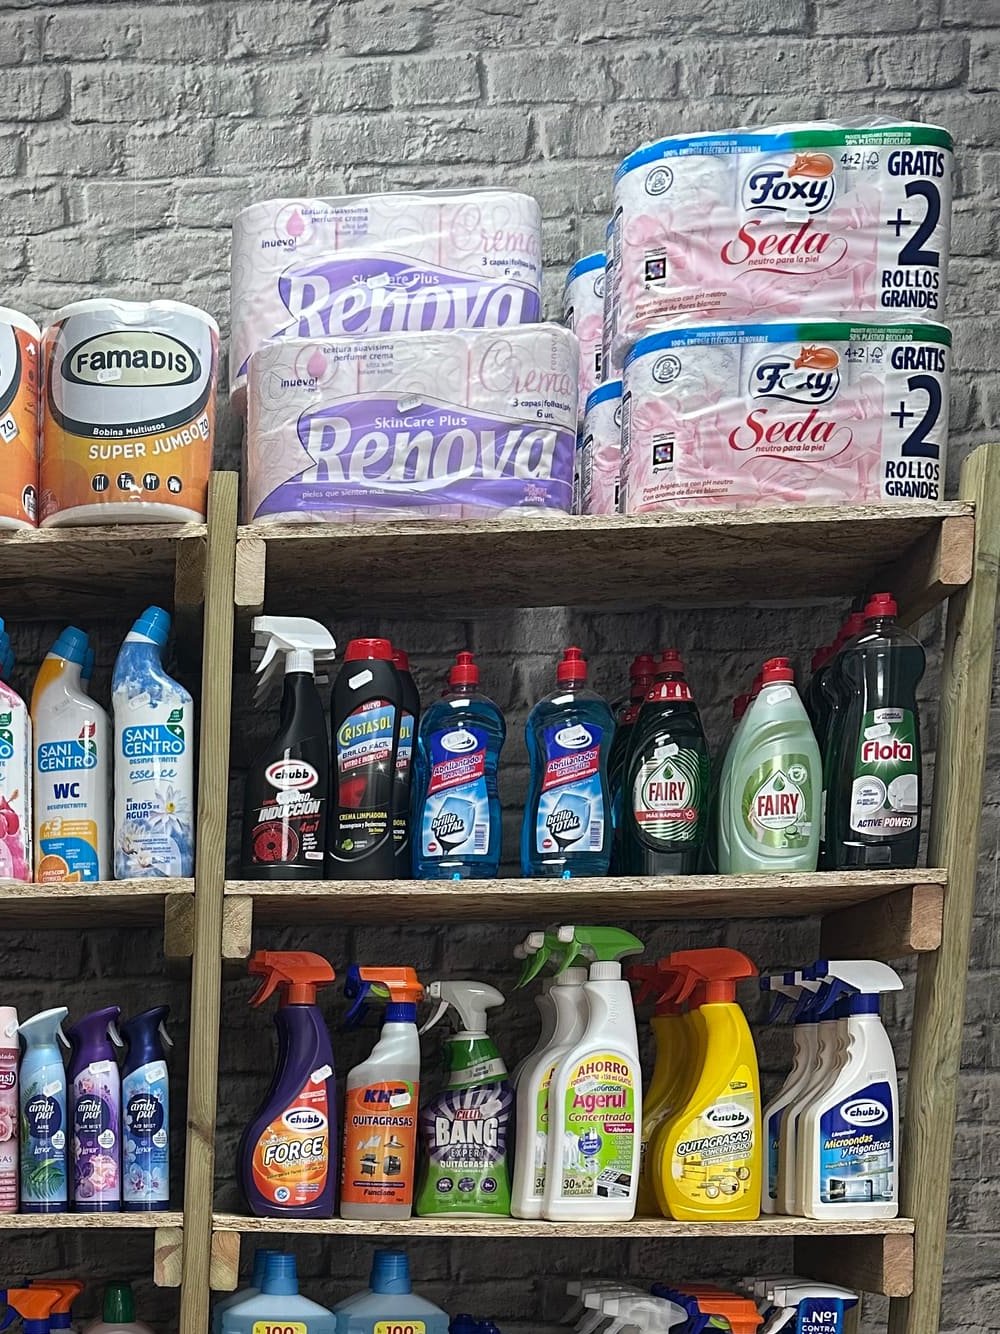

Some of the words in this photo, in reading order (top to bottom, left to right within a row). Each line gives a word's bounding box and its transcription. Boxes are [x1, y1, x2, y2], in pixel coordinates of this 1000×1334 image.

[888, 151, 944, 178] GRATIS
[750, 170, 826, 207] Foxy
[720, 218, 832, 265] Seda
[748, 256, 775, 265] neutro
[776, 257, 795, 265] para
[881, 270, 939, 289] ROLLOS
[284, 274, 526, 337] Renova
[881, 290, 938, 309] GRANDES
[891, 347, 945, 371] GRATIS
[93, 425, 121, 437] Bobina
[123, 422, 166, 435] Multiusos
[375, 417, 434, 429] SkinCare
[439, 415, 467, 426] Plus
[729, 408, 836, 451] Seda
[89, 444, 146, 460] SUPER
[152, 427, 200, 455] JUMBO
[301, 417, 557, 483] Renova
[885, 462, 939, 480] ROLLOS
[885, 480, 939, 500] GRANDES
[125, 728, 158, 742] SANI
[41, 745, 71, 759] SANI
[125, 740, 183, 755] CENTRO
[40, 756, 95, 770] CENTRO
[274, 768, 310, 781] chubb
[53, 783, 80, 799] WC
[649, 781, 685, 802] FAIRY
[126, 802, 153, 811] LIRIOS
[757, 793, 800, 817] FAIRY
[126, 810, 149, 819] AGUA
[857, 818, 883, 828] ACTIVE
[883, 817, 913, 828] POWER
[577, 1062, 629, 1077] AHORRO
[572, 1091, 627, 1111] Agerul
[289, 1114, 320, 1125] chubb
[568, 1112, 632, 1123] Concentrado
[850, 1107, 884, 1119] chubb
[352, 1116, 414, 1127] QUITAGRASAS
[435, 1116, 499, 1148] BANG
[677, 1130, 751, 1155] QUITAGRASAS
[824, 1135, 873, 1149] Microondas
[264, 1136, 325, 1166] FORCE
[439, 1161, 494, 1169] QUITAGRASAS
[802, 1325, 836, 1333] CONTRA
